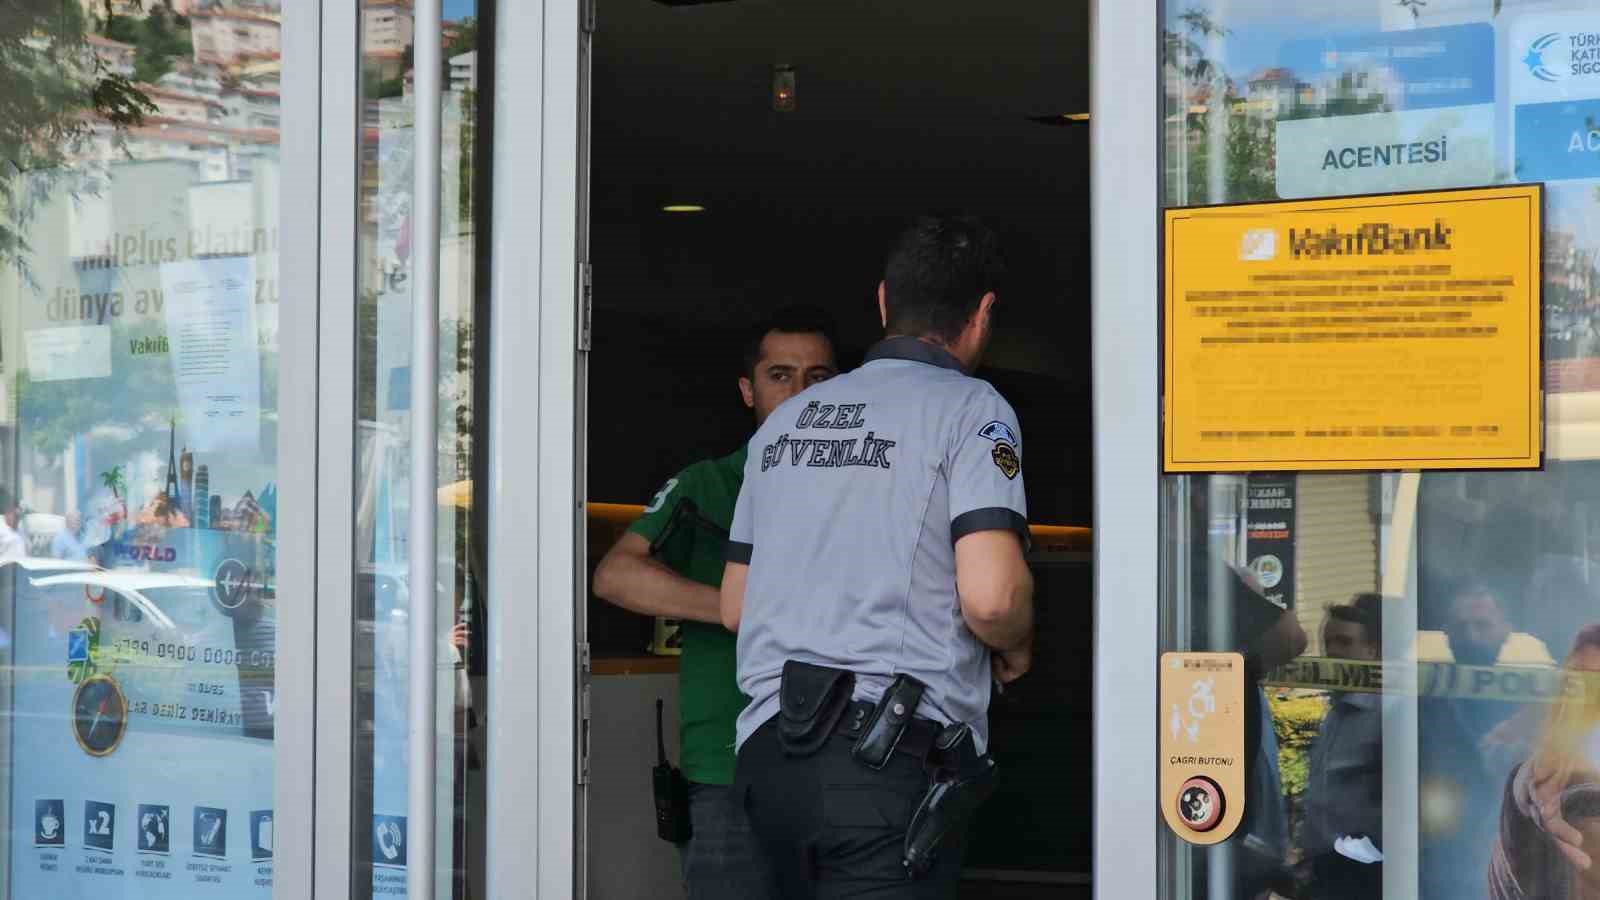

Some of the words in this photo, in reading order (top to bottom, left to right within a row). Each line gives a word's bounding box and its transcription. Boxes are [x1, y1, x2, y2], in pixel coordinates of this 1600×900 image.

[1321, 136, 1448, 170] ACENTESİ
[795, 401, 866, 429] ÖZEL
[761, 432, 896, 472] GÜVENLİK
[88, 810, 111, 836] x2
